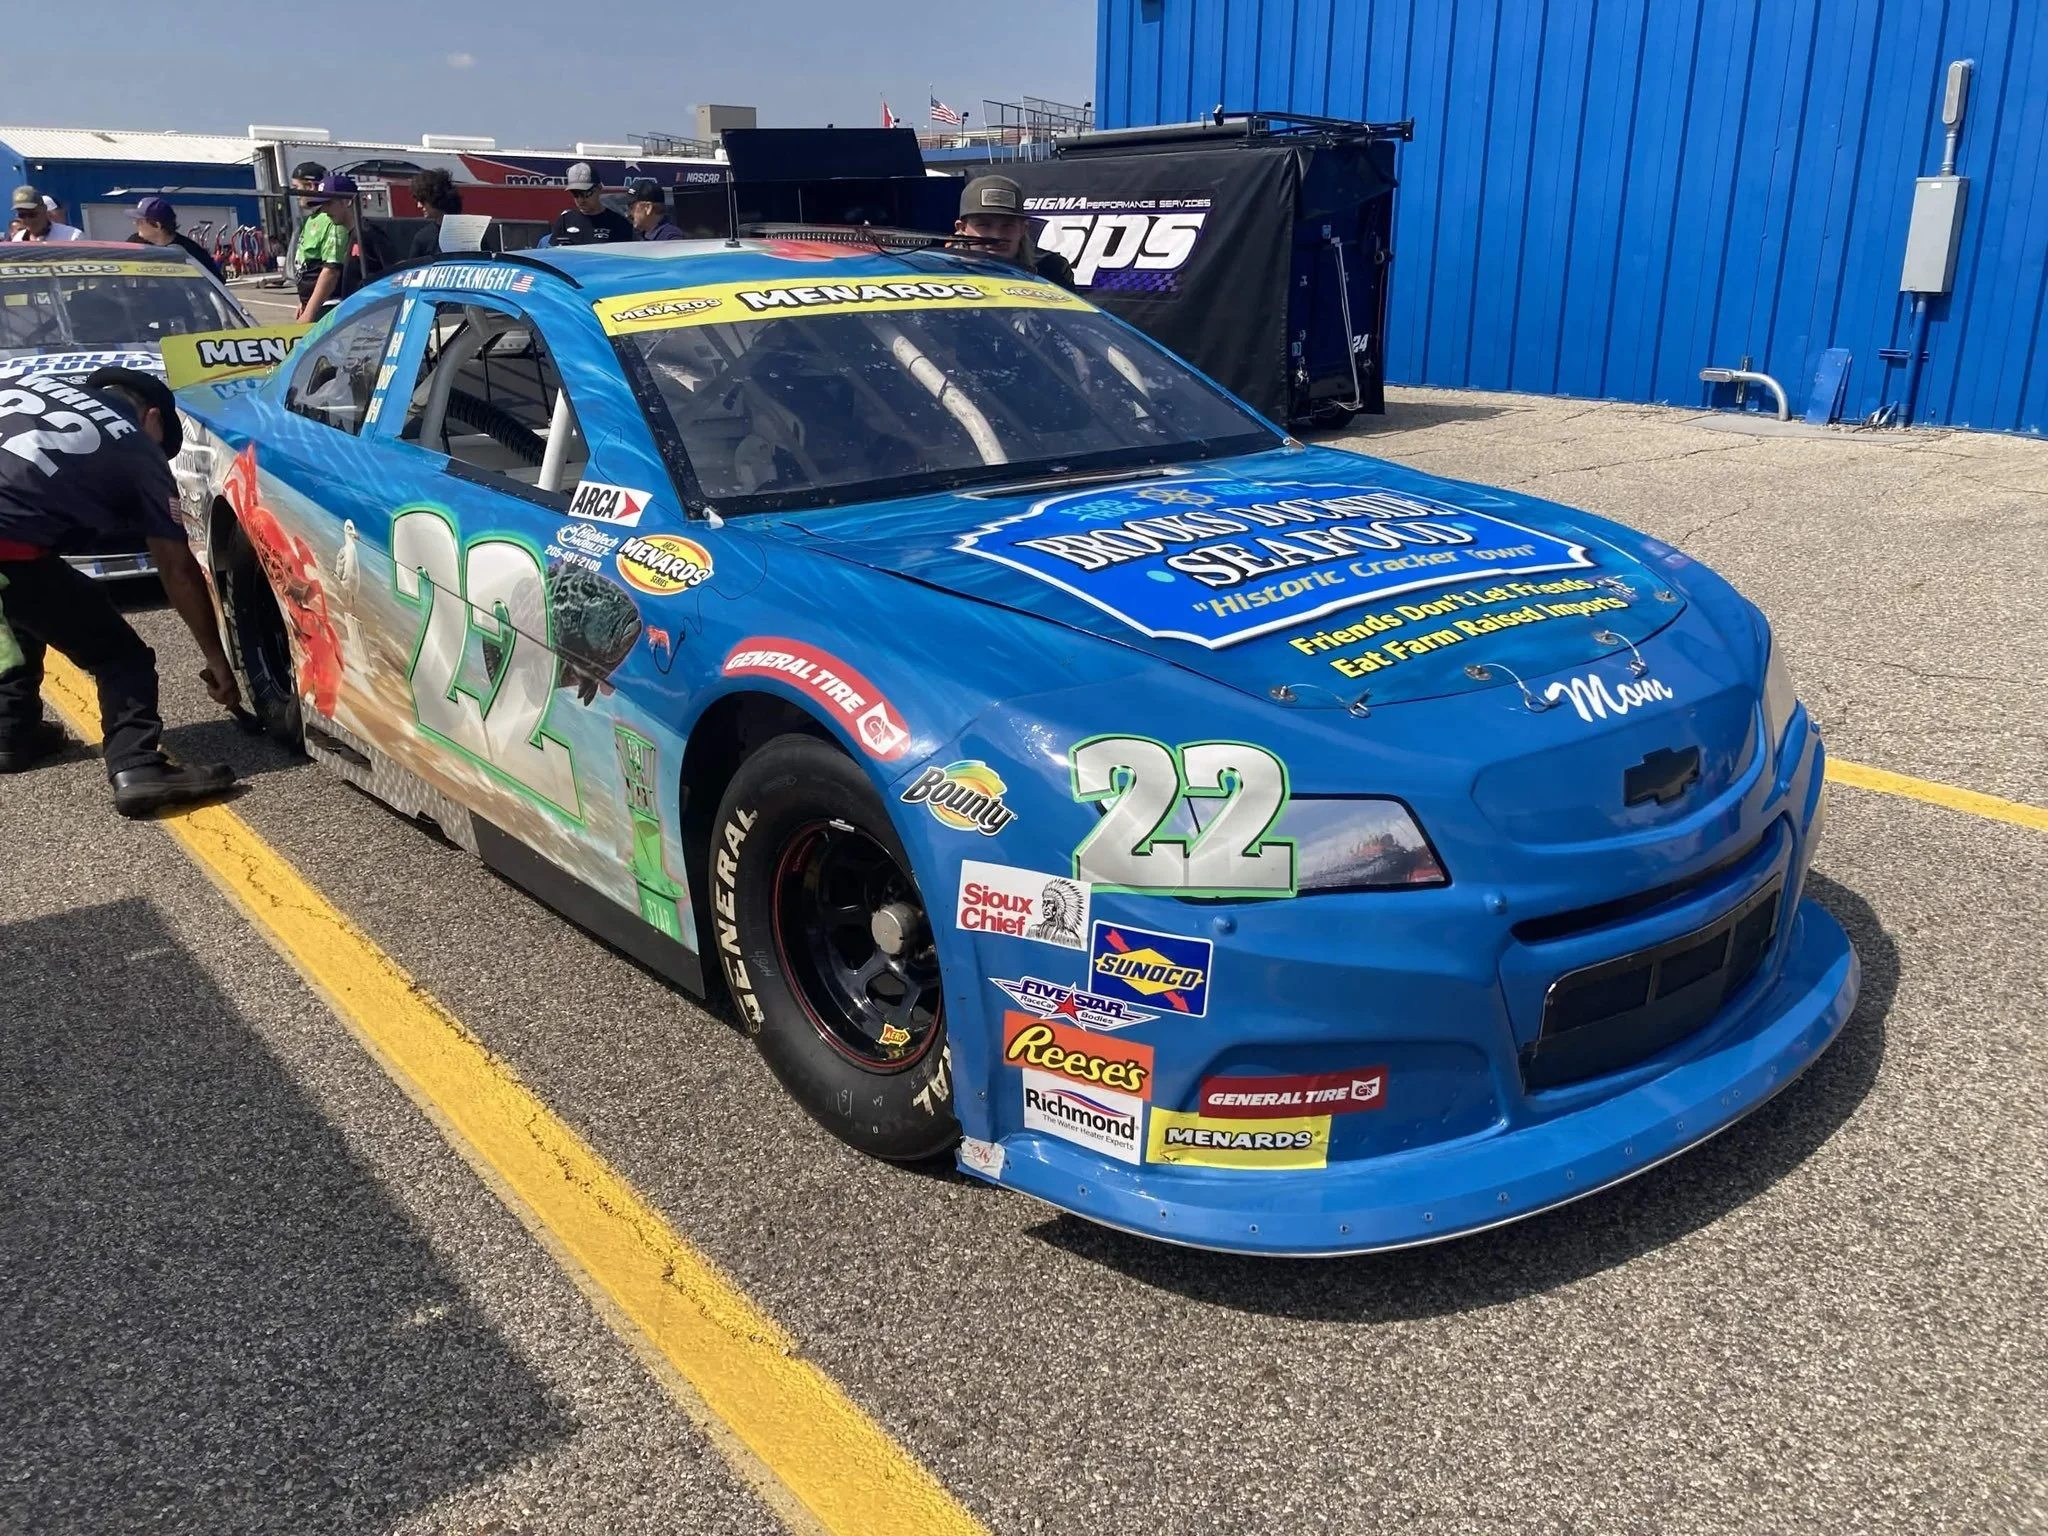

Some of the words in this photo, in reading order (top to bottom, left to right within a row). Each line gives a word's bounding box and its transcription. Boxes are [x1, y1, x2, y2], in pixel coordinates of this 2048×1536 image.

[686, 172, 720, 184] NASCAR
[1023, 197, 1088, 210] SIGMA
[1087, 199, 1156, 209] PERFORMANCE
[1159, 198, 1212, 208] SERVICES
[1, 264, 122, 276] ENARDS
[424, 266, 521, 291] WHITEKNIGHT
[611, 298, 723, 322] MENARDS
[739, 282, 987, 312] MENARDS
[197, 337, 303, 368] MEN
[15, 373, 137, 440] WHITE
[571, 485, 621, 519] ARCA
[1013, 510, 1250, 571] BROOKS
[1166, 521, 1475, 588] SEAFOOD
[618, 536, 712, 587] MENARDS
[1349, 550, 1459, 578] Cracker
[650, 575, 669, 588] SERIES
[1289, 613, 1404, 655] Friends
[1394, 594, 1476, 622] Don't
[1465, 585, 1514, 604] Let
[1512, 577, 1595, 597] Friends
[1329, 650, 1394, 678] Eat
[1381, 627, 1463, 661] Farm
[1452, 606, 1547, 637] Raised
[1535, 596, 1630, 617] Imports
[391, 508, 585, 825] 22
[725, 650, 818, 680] GENERAL
[809, 668, 867, 714] TIRE
[1544, 673, 1674, 722] Mom
[902, 766, 1015, 836] Bounty
[1070, 734, 1299, 898] 22
[962, 882, 1033, 915] Sioux
[960, 907, 1026, 936] Chief
[1096, 951, 1201, 989] SUNOCO
[1020, 980, 1069, 1001] FIVE
[1074, 993, 1124, 1018] STAR
[884, 1030, 905, 1041] AERO
[1005, 1022, 1150, 1093] Reese's
[1025, 1087, 1136, 1141] Richmond
[1208, 1091, 1303, 1106] GENERAL
[1304, 1087, 1350, 1104] TIRE
[1043, 1114, 1057, 1124] The
[1058, 1119, 1079, 1132] Water
[1080, 1127, 1105, 1140] Heater
[1106, 1136, 1134, 1151] Experts
[1164, 1127, 1313, 1150] MENARDS
